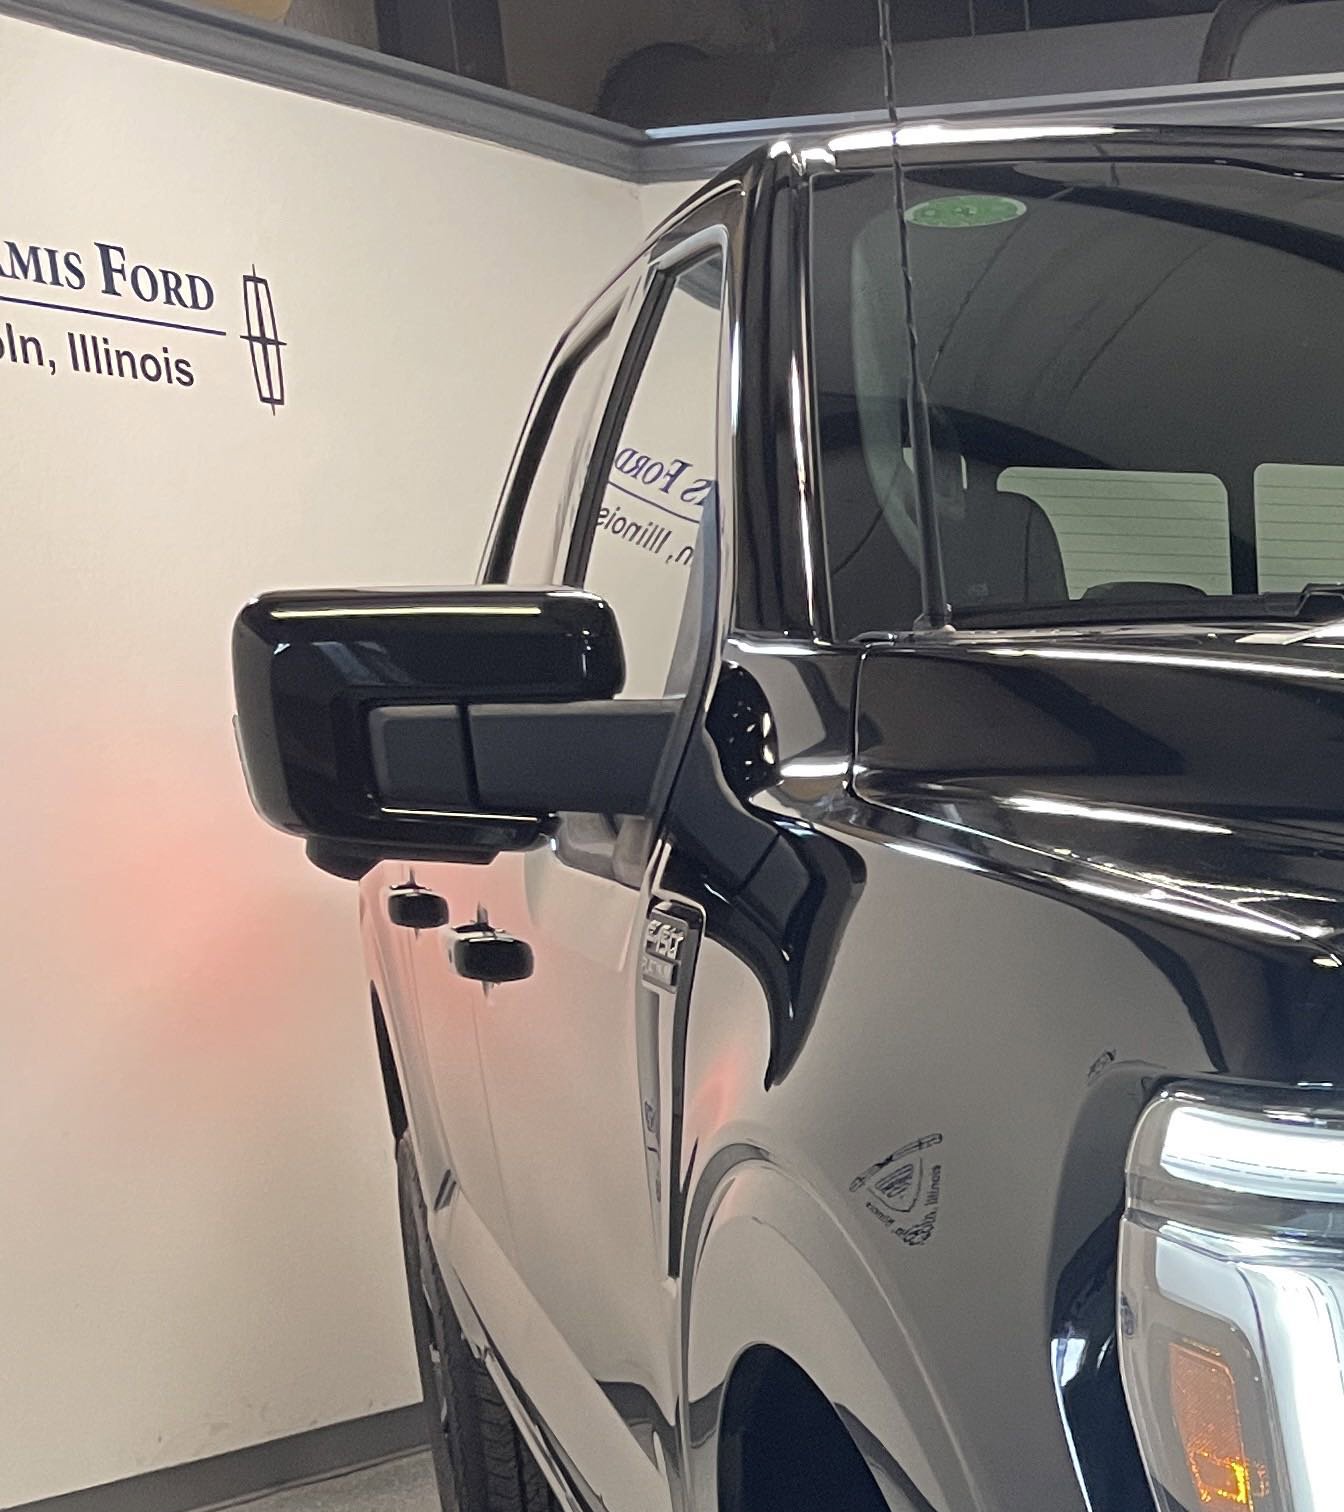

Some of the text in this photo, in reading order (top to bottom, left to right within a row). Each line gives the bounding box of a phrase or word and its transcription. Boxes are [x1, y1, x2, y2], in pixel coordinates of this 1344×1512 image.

[94, 241, 215, 311] FORD
[0, 322, 195, 387] ln, Illinois
